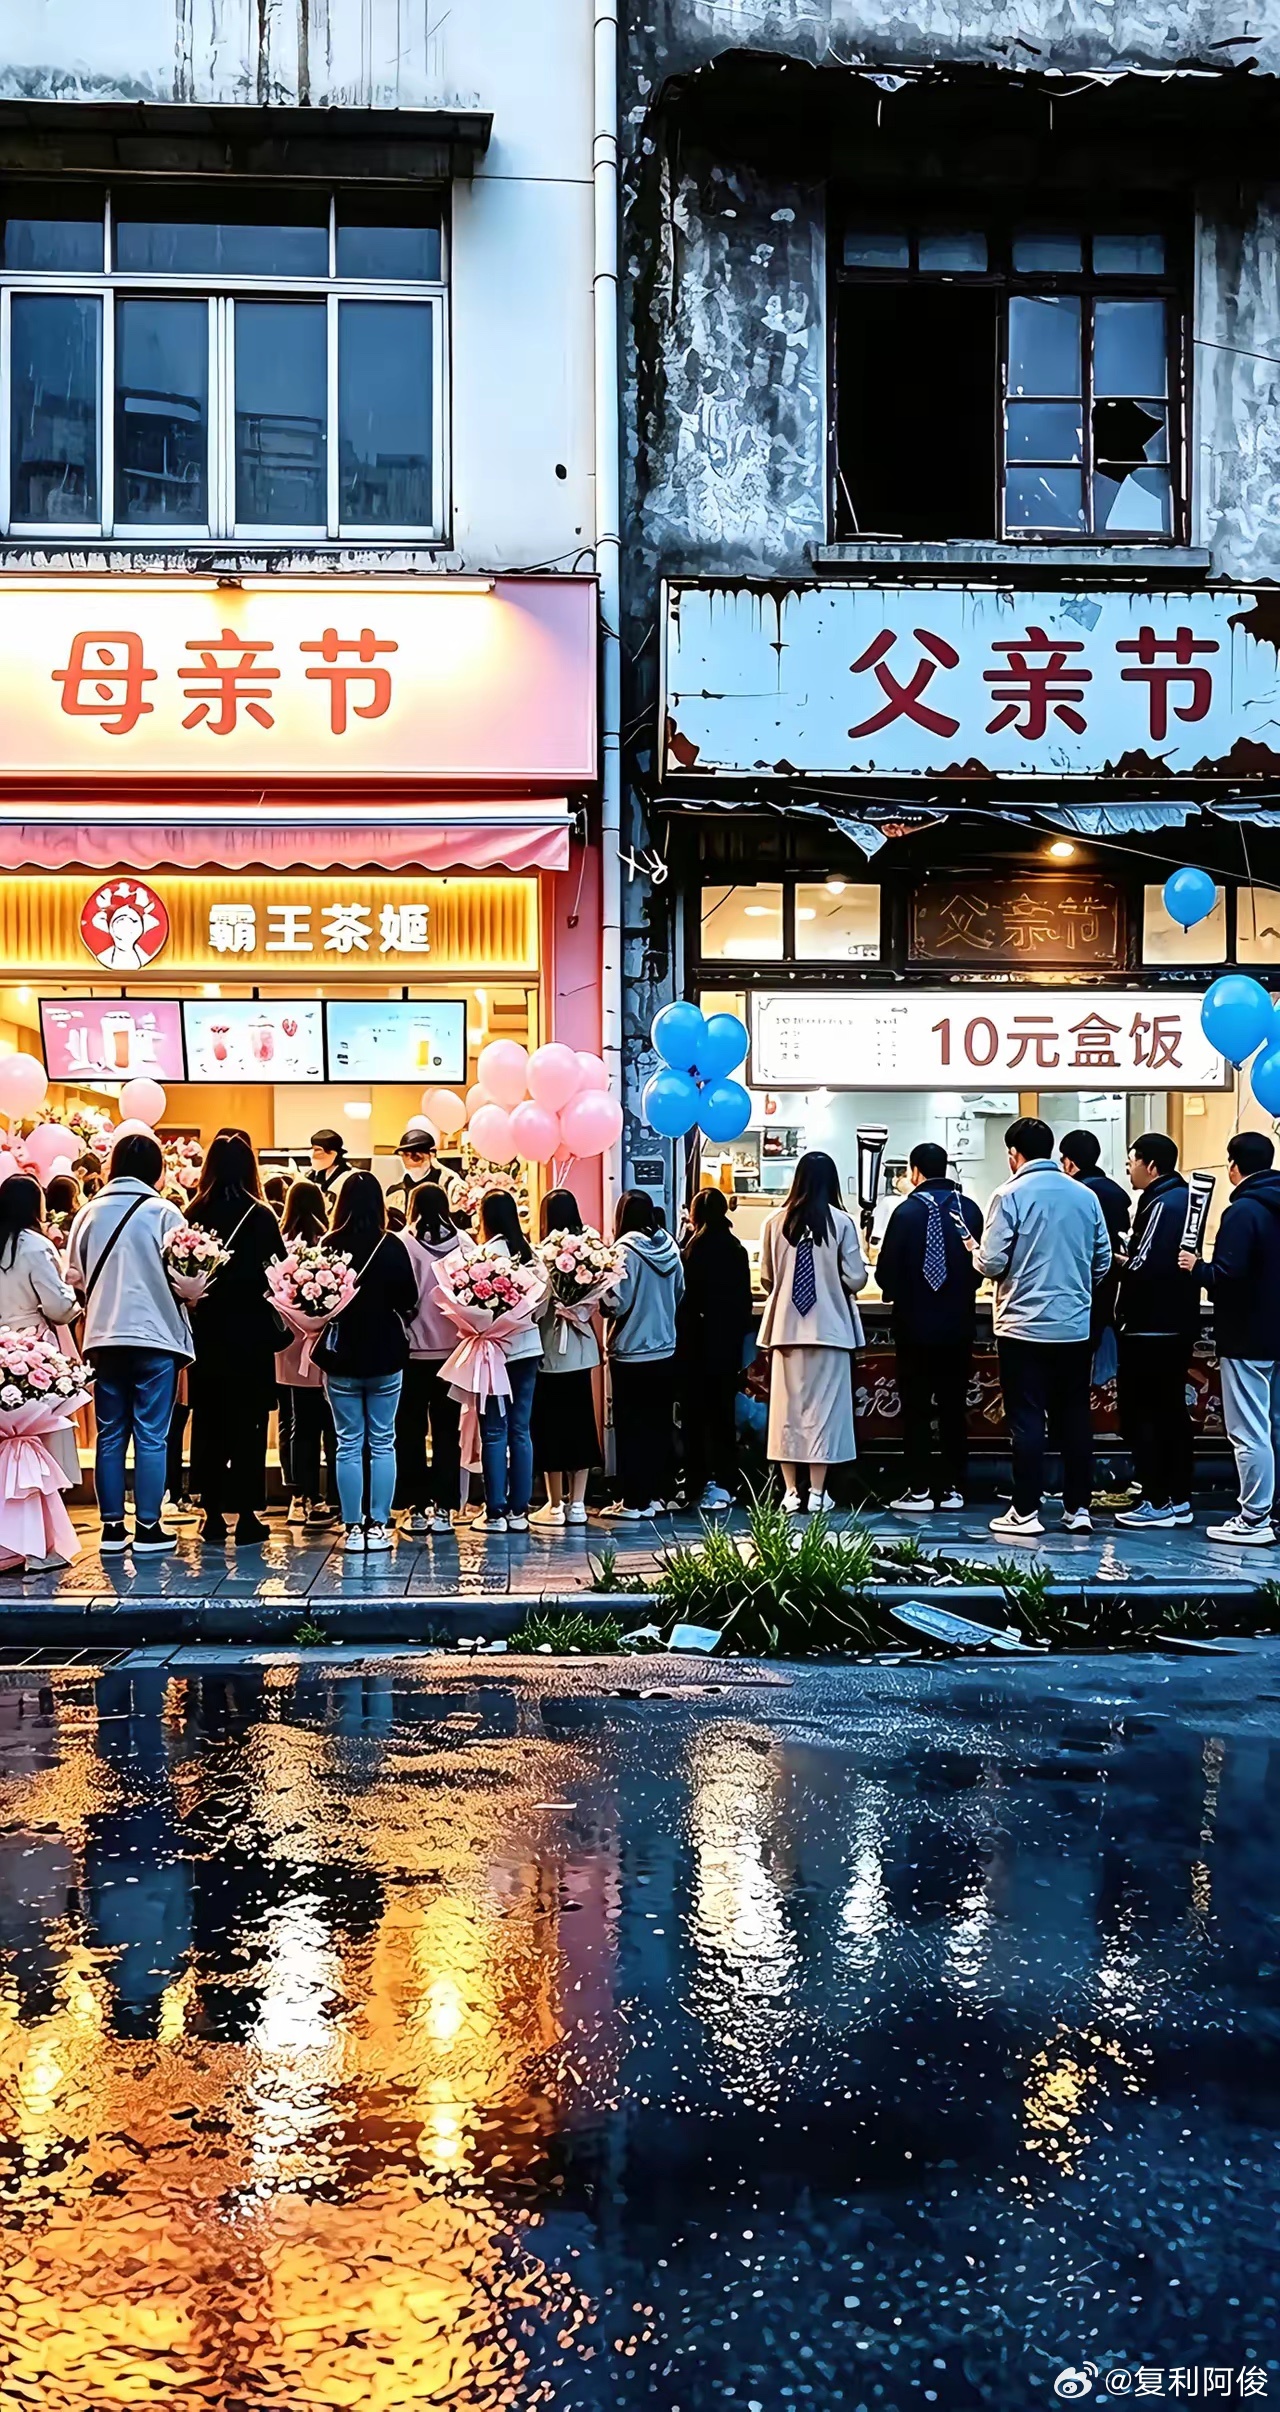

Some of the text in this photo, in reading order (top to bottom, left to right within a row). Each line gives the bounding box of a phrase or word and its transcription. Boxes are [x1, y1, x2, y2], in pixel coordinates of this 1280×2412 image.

[51, 627, 399, 736] 母亲节
[848, 626, 1220, 741] 父亲节
[208, 903, 431, 954] 霸王茶姬
[931, 1011, 1184, 1070] 10元盒饭
